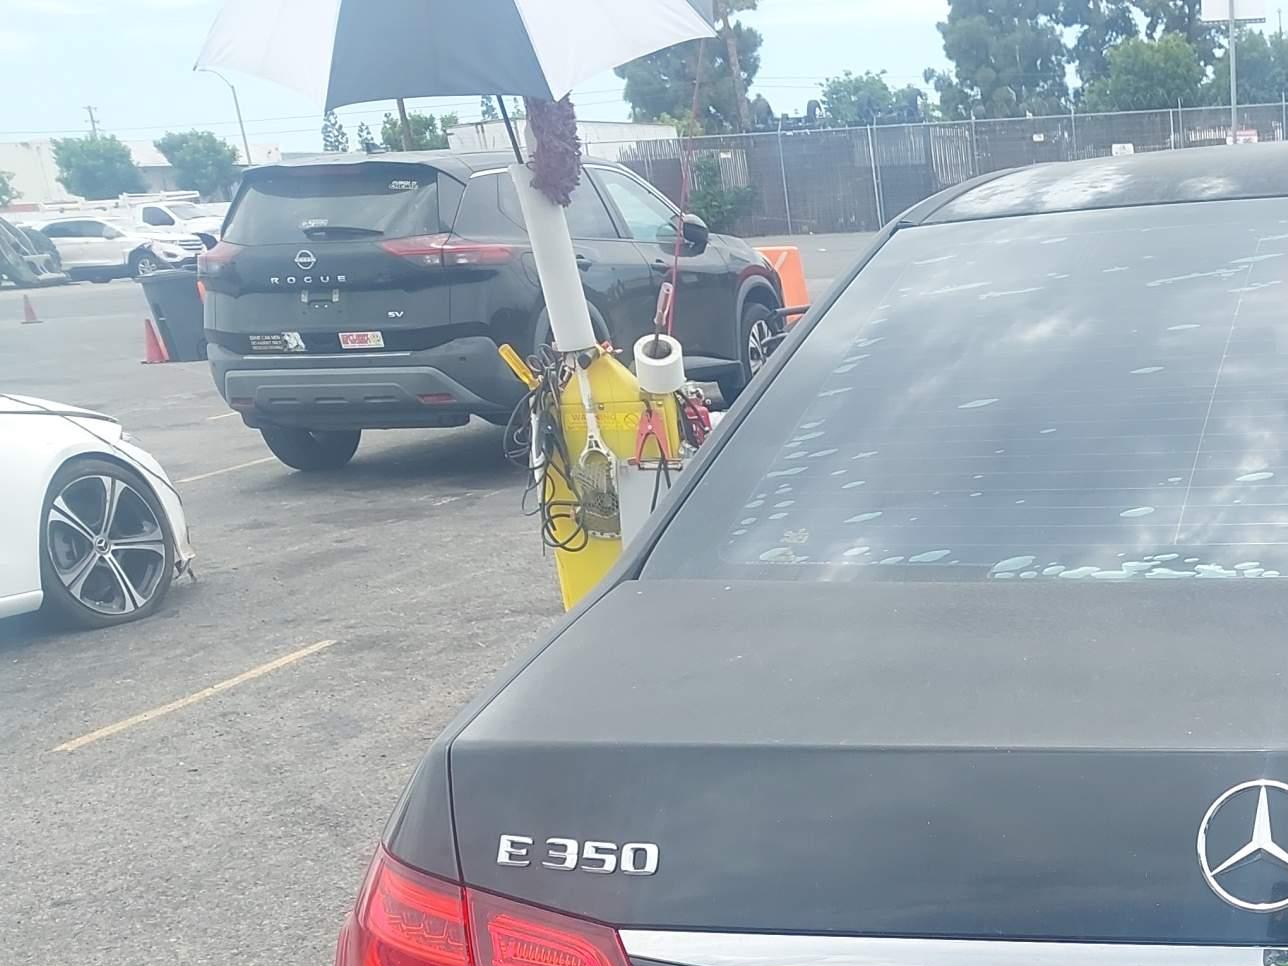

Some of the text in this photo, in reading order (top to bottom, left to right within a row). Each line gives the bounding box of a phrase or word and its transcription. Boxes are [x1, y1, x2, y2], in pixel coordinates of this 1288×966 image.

[270, 274, 347, 285] ROGUE
[496, 834, 659, 876] E 350
